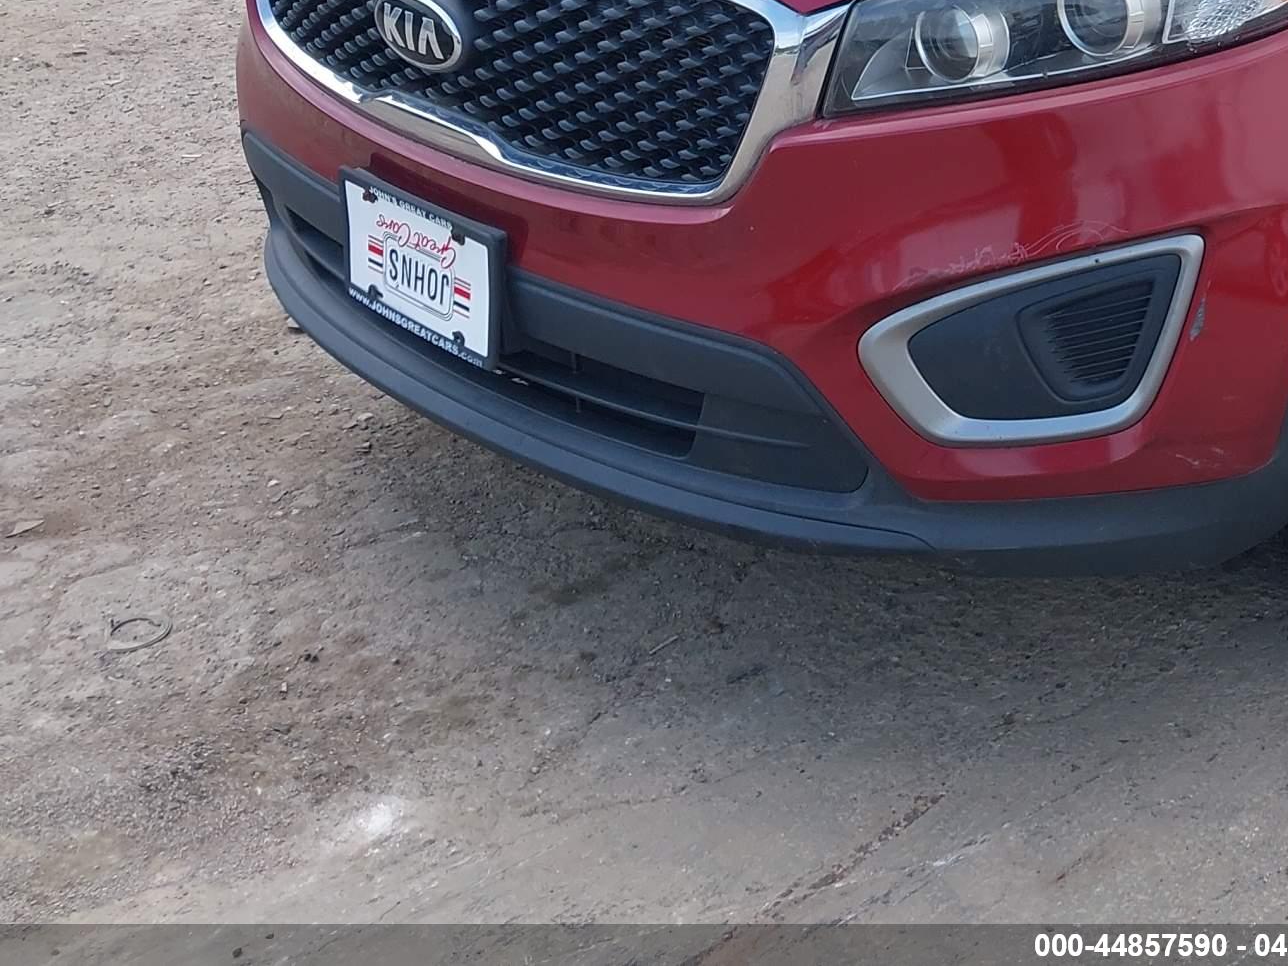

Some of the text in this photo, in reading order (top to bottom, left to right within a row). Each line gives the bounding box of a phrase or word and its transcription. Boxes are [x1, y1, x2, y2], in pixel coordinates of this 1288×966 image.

[383, 2, 445, 60] KIA
[399, 200, 427, 219] GREAT
[428, 211, 453, 231] CARS
